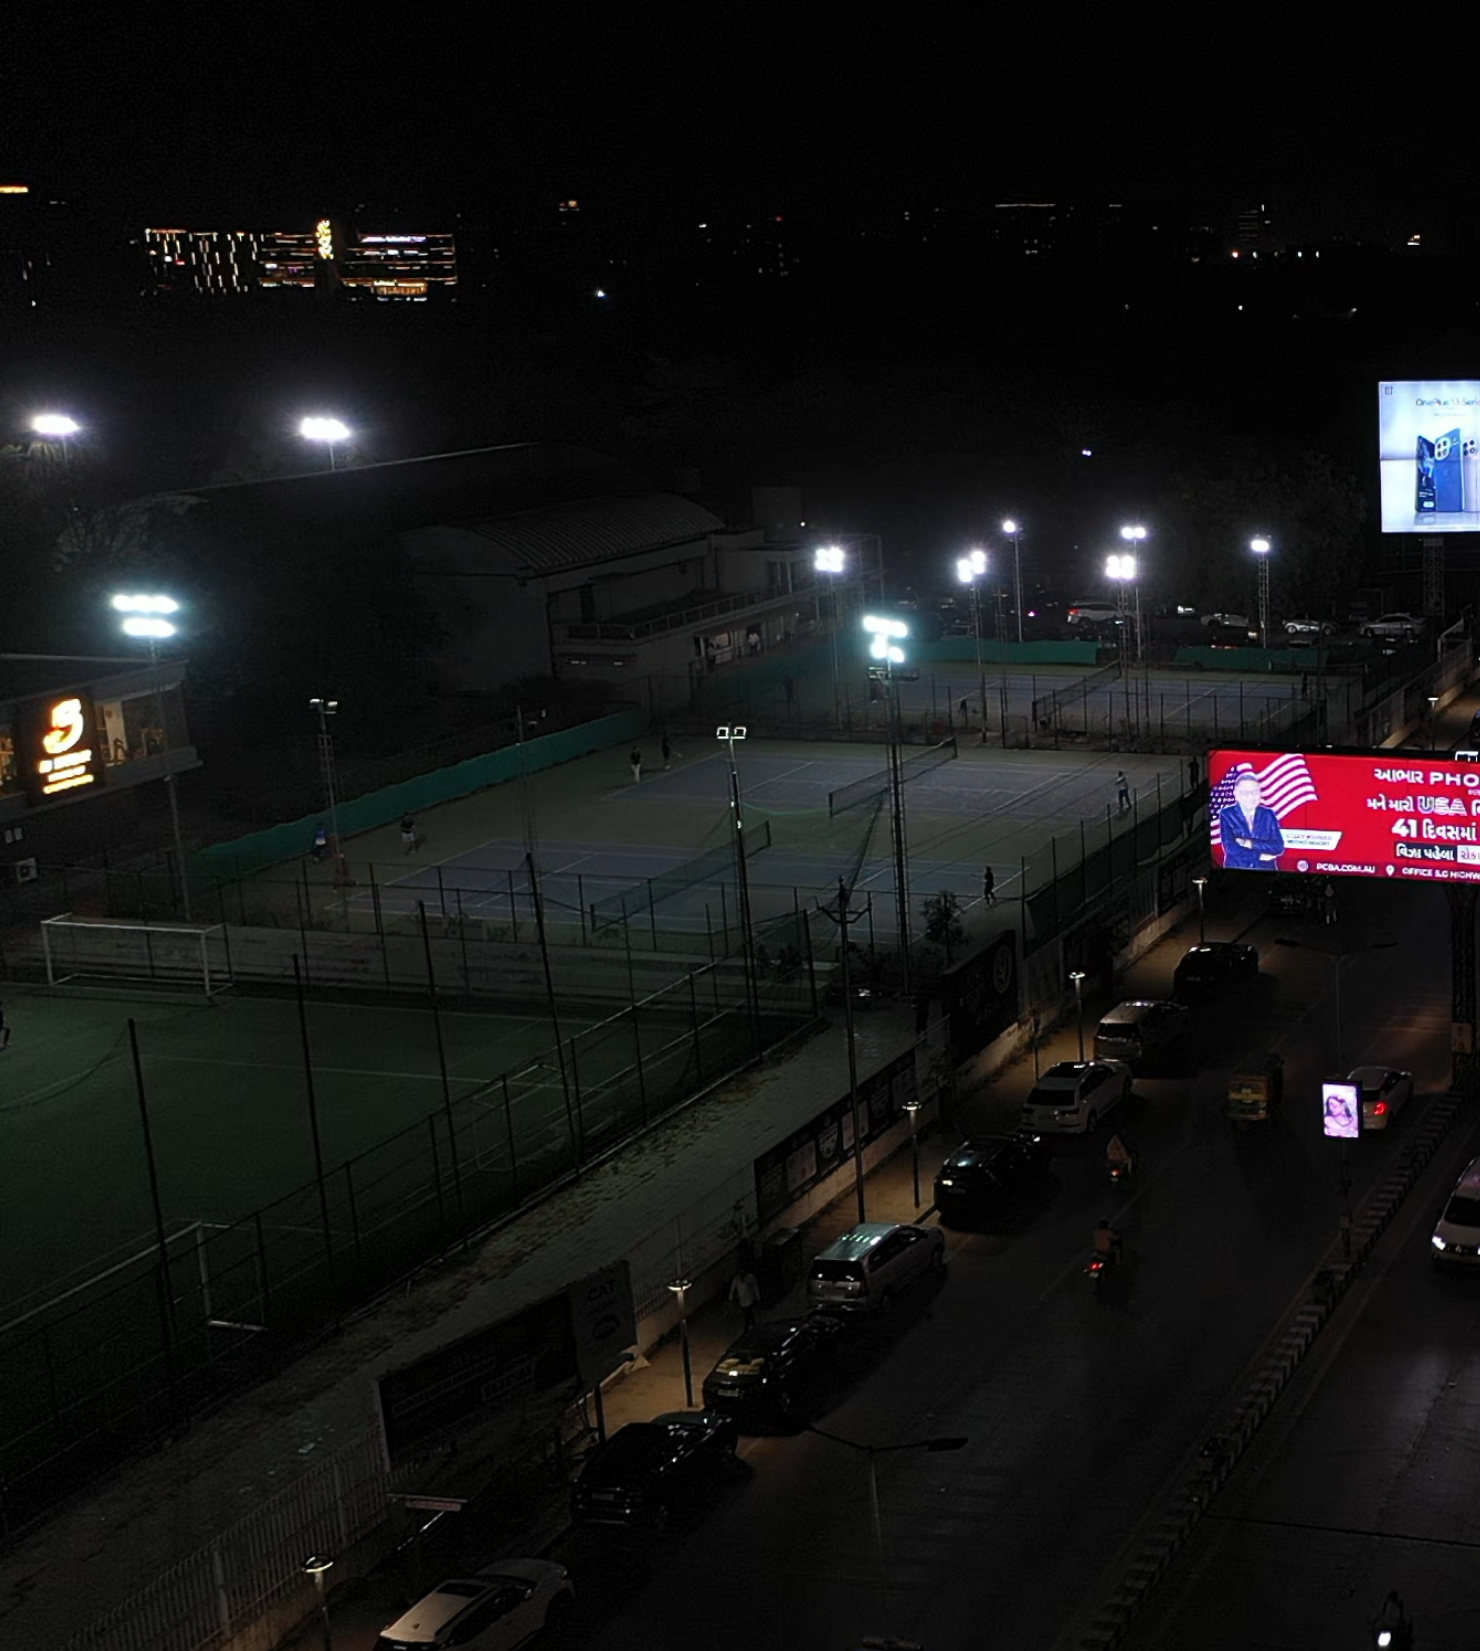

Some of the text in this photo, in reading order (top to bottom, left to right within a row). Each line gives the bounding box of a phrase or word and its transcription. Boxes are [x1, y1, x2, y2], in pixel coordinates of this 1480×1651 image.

[1373, 768, 1424, 784] આભાર
[1366, 793, 1387, 811] મને
[1388, 796, 1415, 812] મારો
[1417, 796, 1468, 816] USA
[1391, 818, 1418, 838] 41
[1422, 818, 1477, 841] દિવસમાં
[1402, 866, 1432, 877] OFFICE
